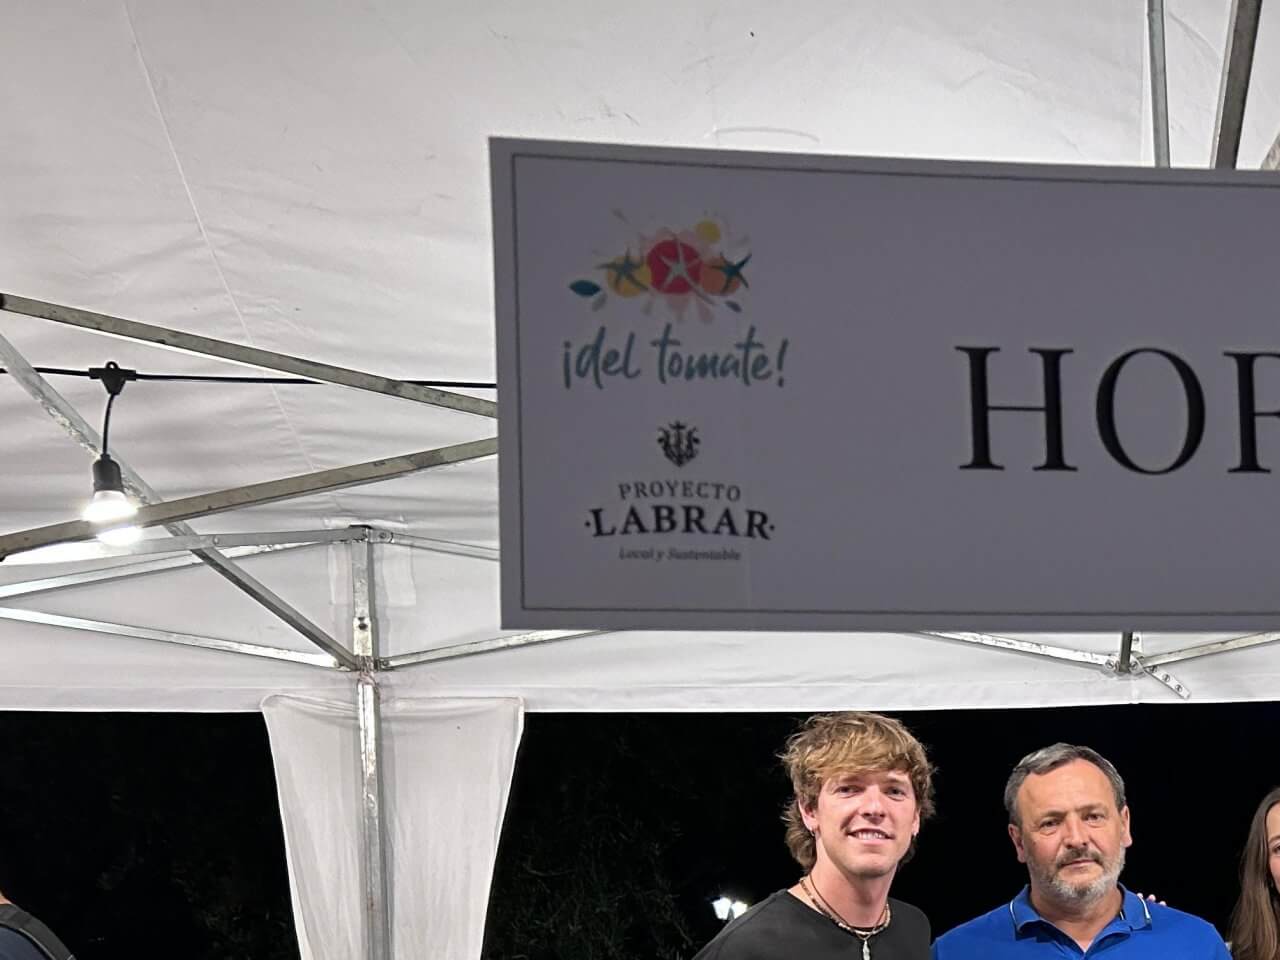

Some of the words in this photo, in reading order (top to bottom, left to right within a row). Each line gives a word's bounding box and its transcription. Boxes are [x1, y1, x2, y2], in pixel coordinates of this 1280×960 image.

[650, 323, 790, 388] tomate!
[618, 479, 742, 502] PROYECTO
[618, 547, 653, 561] Local
[665, 547, 742, 562] Sustentable
